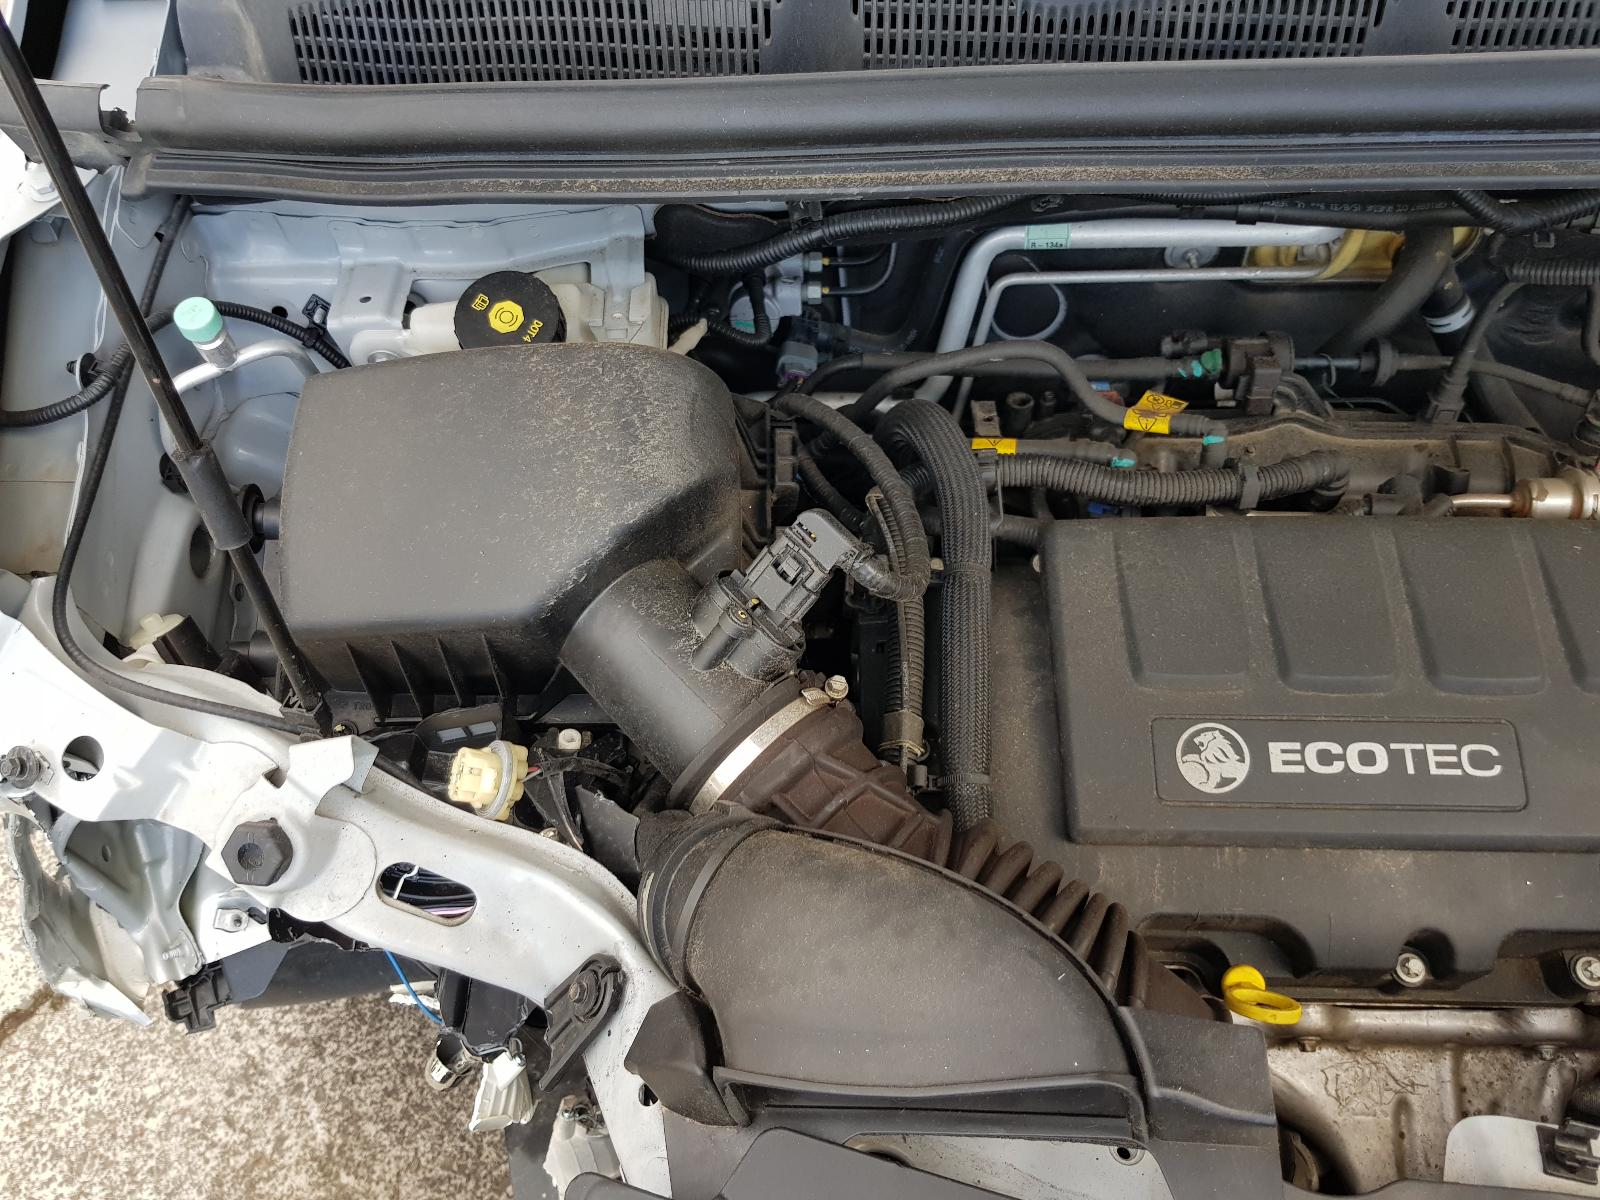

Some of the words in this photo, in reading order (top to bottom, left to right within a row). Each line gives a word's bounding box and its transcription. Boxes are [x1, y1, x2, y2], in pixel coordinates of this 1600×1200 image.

[527, 319, 544, 338] DOT
[522, 335, 531, 343] 4
[1268, 741, 1502, 777] ECOTEC
